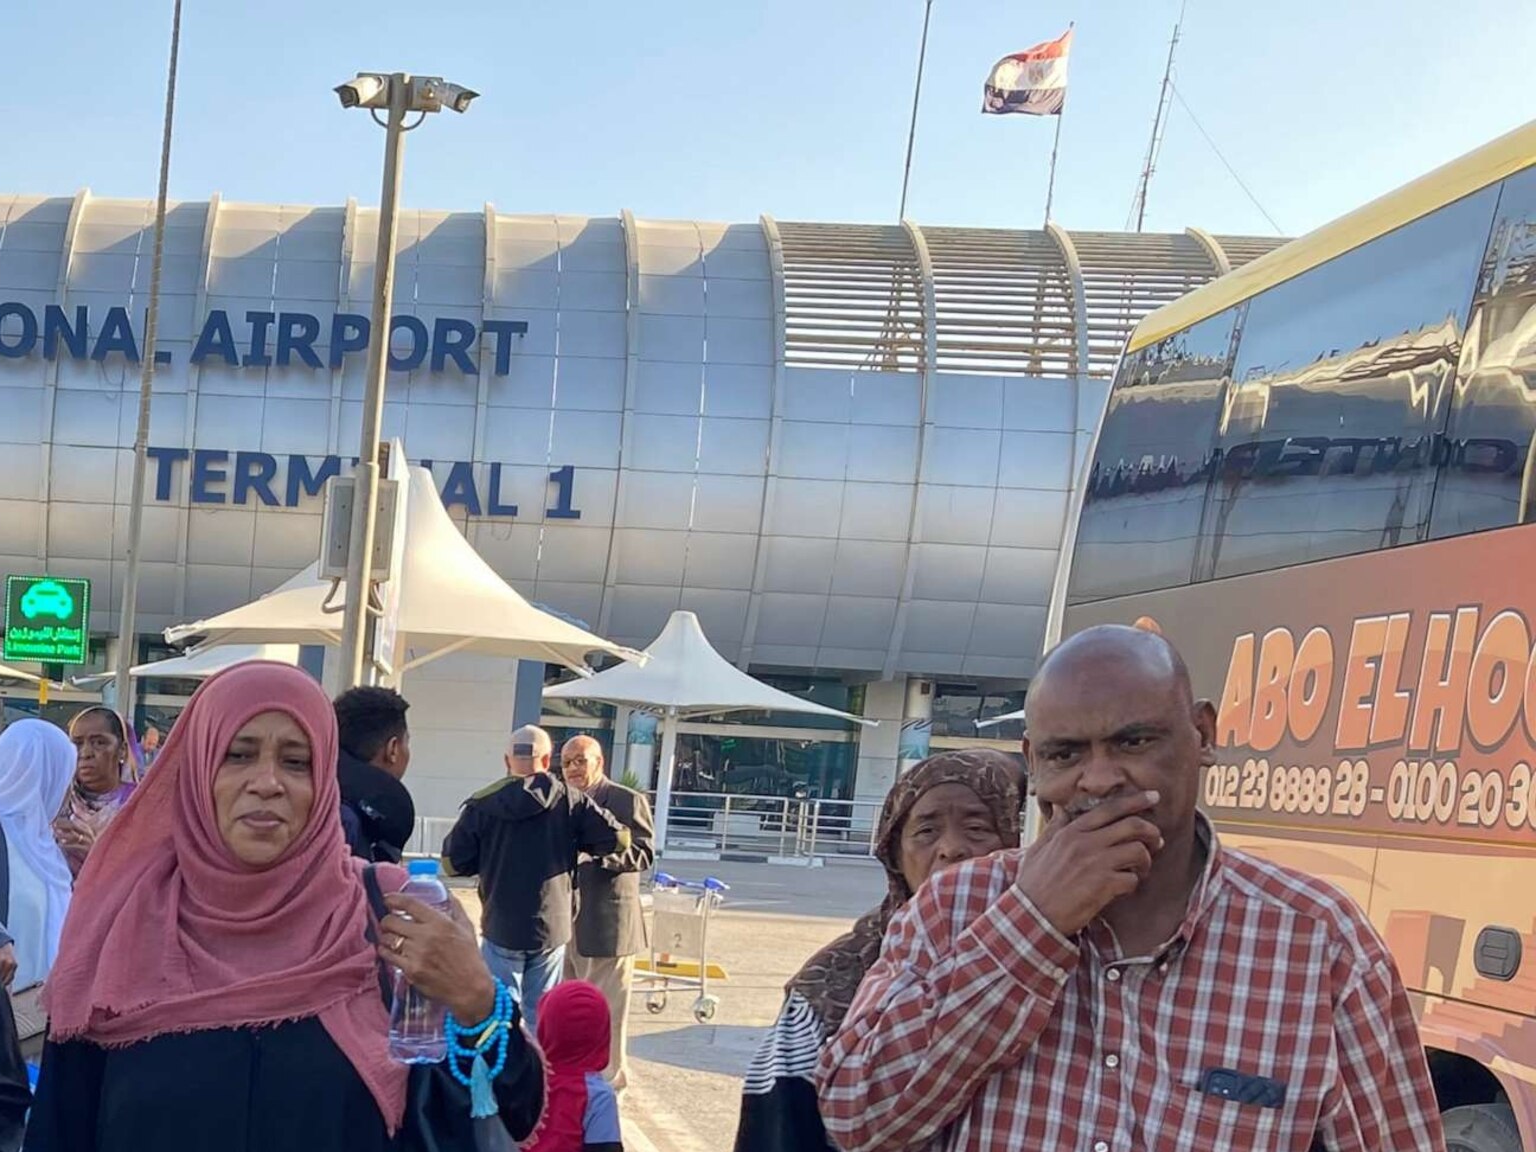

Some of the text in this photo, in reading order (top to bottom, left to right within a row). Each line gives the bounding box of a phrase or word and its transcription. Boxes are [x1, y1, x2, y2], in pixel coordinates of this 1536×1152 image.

[190, 309, 529, 377] AIRPORT
[147, 447, 582, 519] TERMAL 1
[1215, 626, 1333, 752] ABO
[1386, 758, 1457, 823] 0100
[1458, 769, 1502, 826] 20
